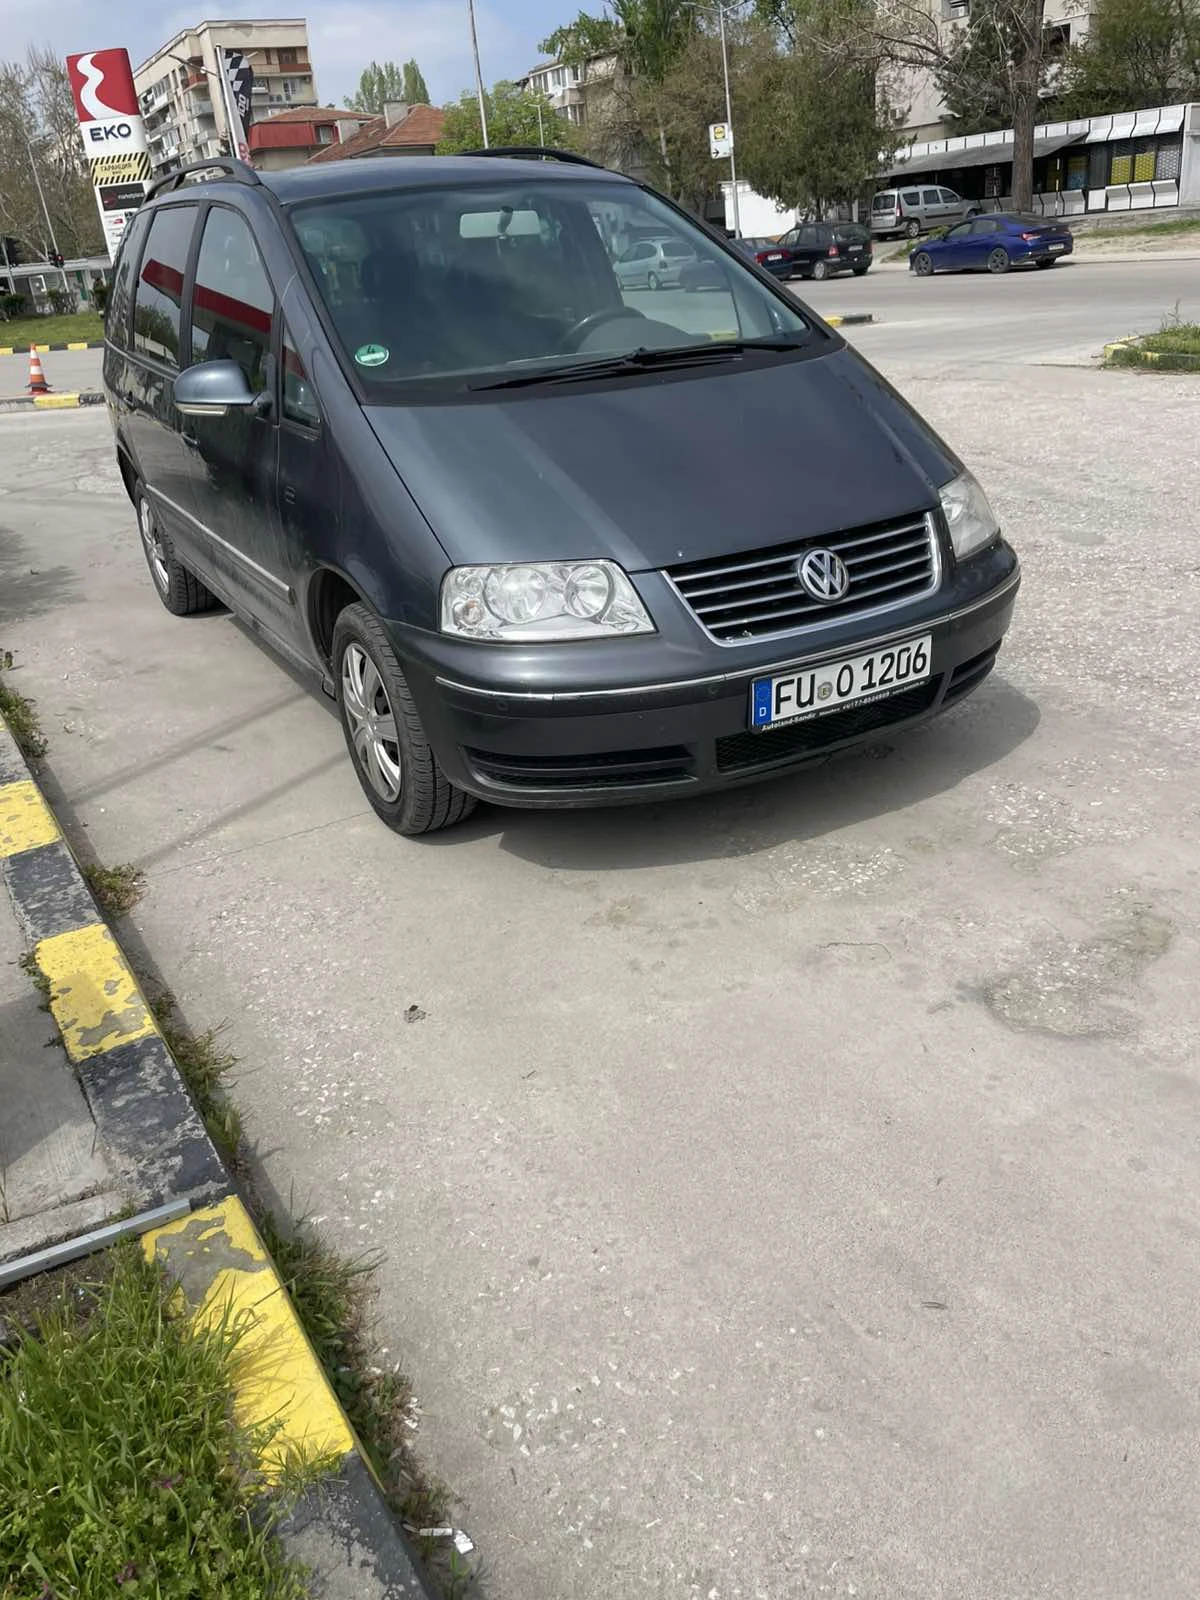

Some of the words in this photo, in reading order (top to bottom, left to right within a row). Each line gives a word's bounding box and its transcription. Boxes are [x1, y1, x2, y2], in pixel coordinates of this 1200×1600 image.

[89, 123, 132, 142] EKO
[774, 673, 816, 715] FU
[836, 663, 854, 698] O
[860, 642, 928, 692] 1206
[759, 706, 767, 718] D
